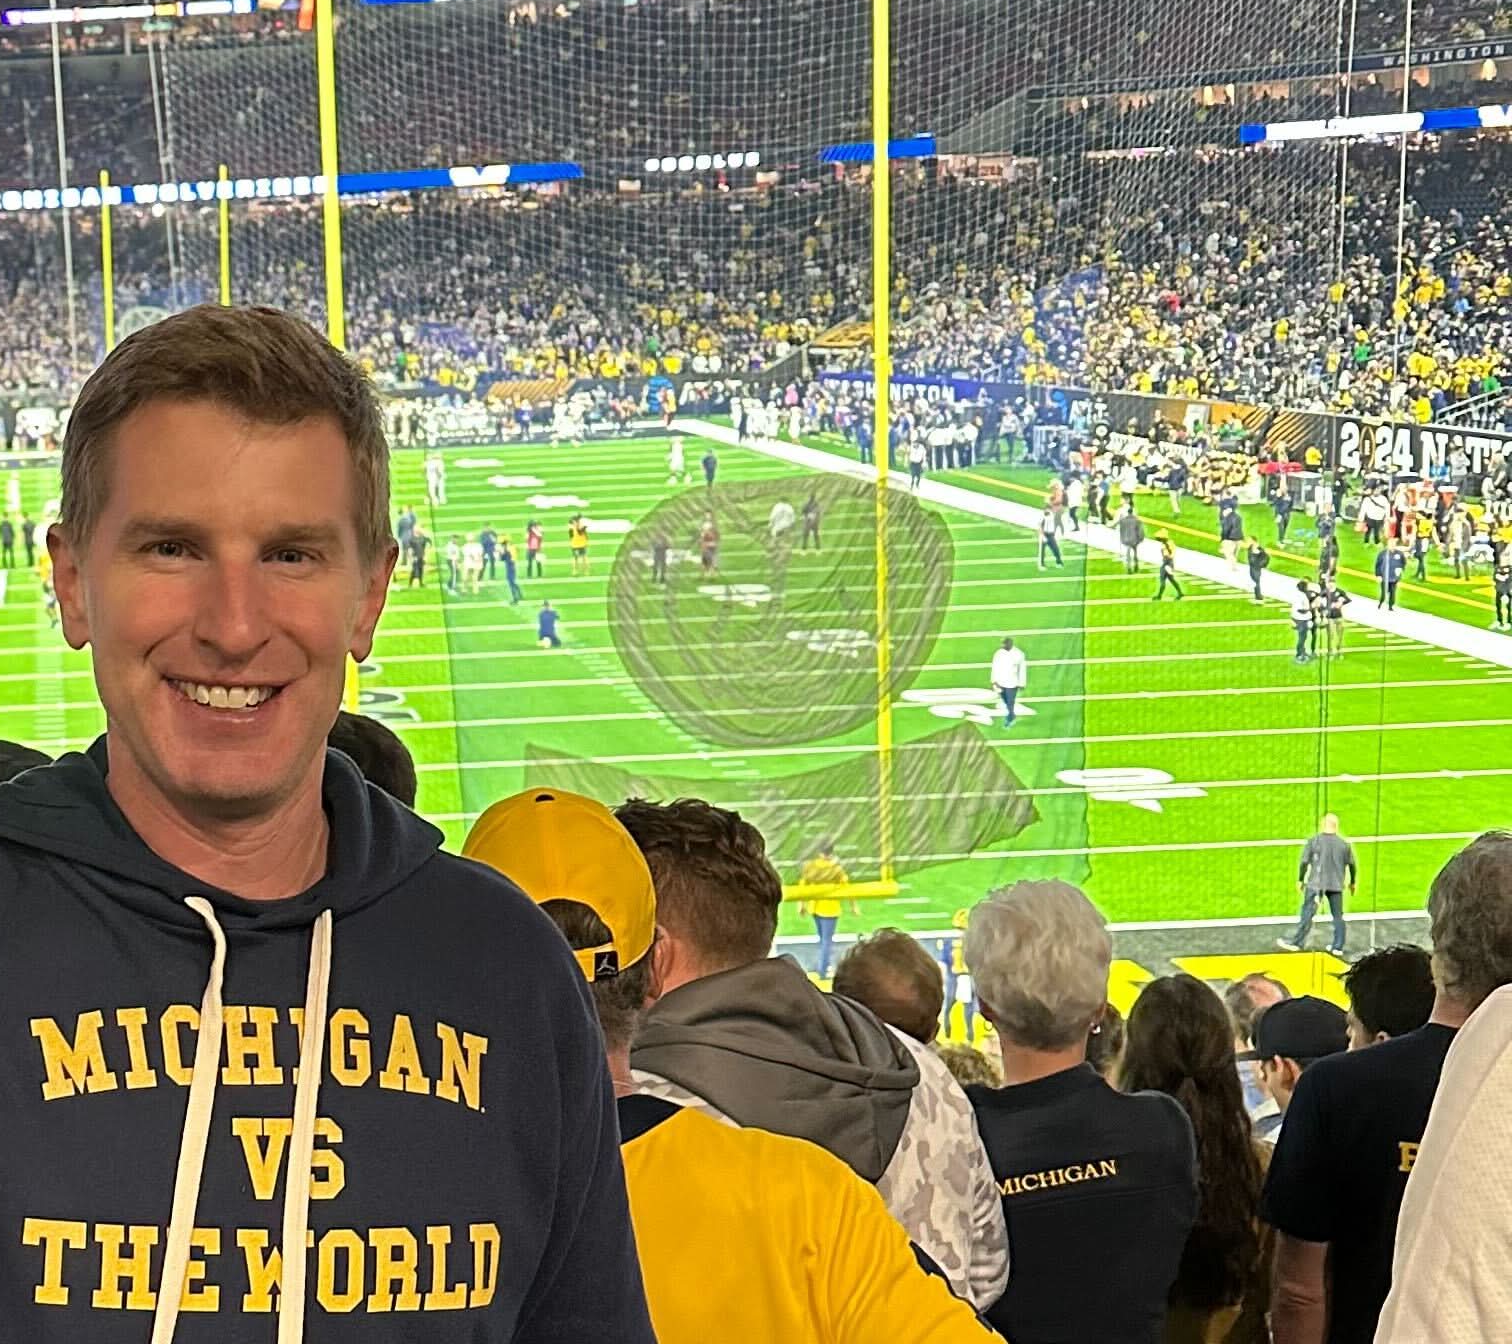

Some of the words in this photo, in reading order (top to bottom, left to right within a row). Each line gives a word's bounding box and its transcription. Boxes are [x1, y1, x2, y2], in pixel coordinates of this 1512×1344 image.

[1383, 44, 1506, 67] WASHINGTON
[823, 376, 956, 404] WASHNGTON
[231, 1117, 346, 1200] VS
[995, 1159, 1118, 1196] MICHIGAN
[22, 1217, 221, 1312] THE
[236, 1223, 501, 1313] WORLD
